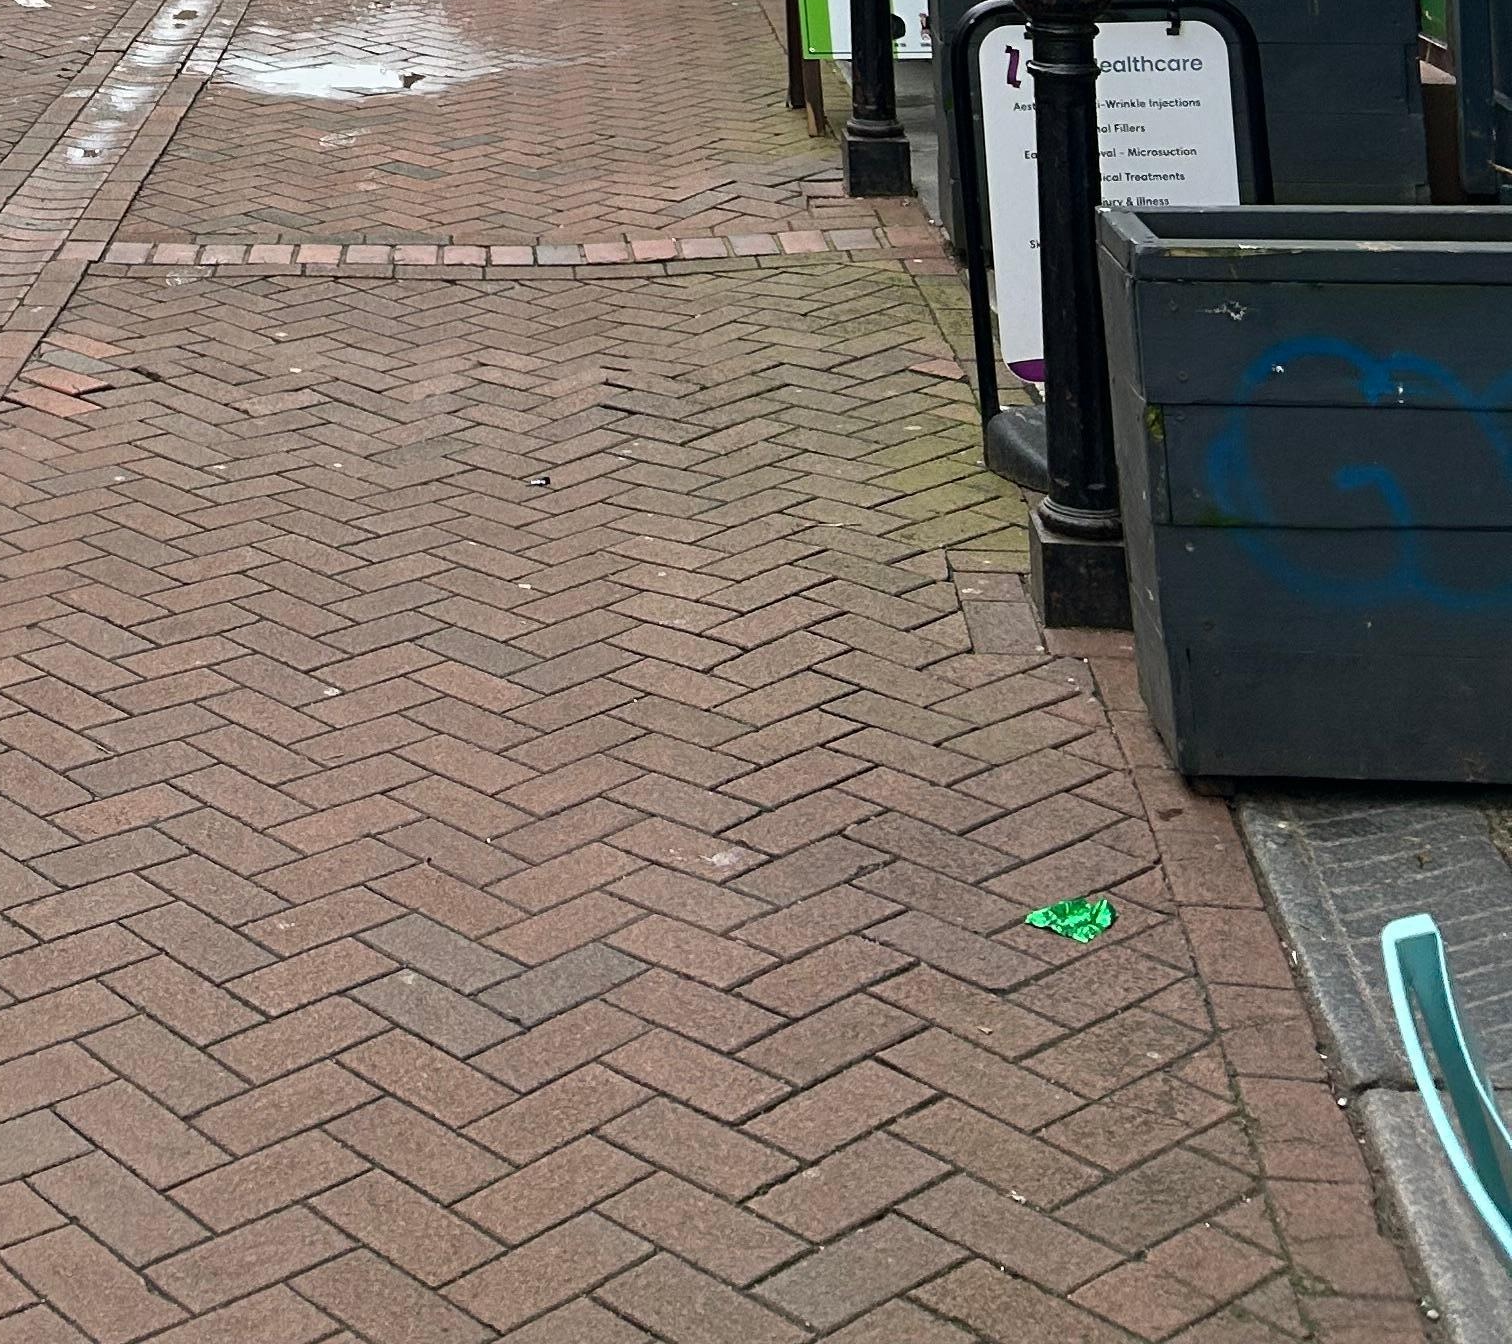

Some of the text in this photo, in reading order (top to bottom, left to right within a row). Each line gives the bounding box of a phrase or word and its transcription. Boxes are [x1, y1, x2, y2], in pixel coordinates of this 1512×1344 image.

[1148, 98, 1201, 110] Injections
[1114, 123, 1146, 133] Fillers
[1127, 147, 1198, 157] Microsuction
[1125, 172, 1186, 182] Treatments
[1125, 196, 1134, 206] &
[1136, 196, 1170, 206] Illness
